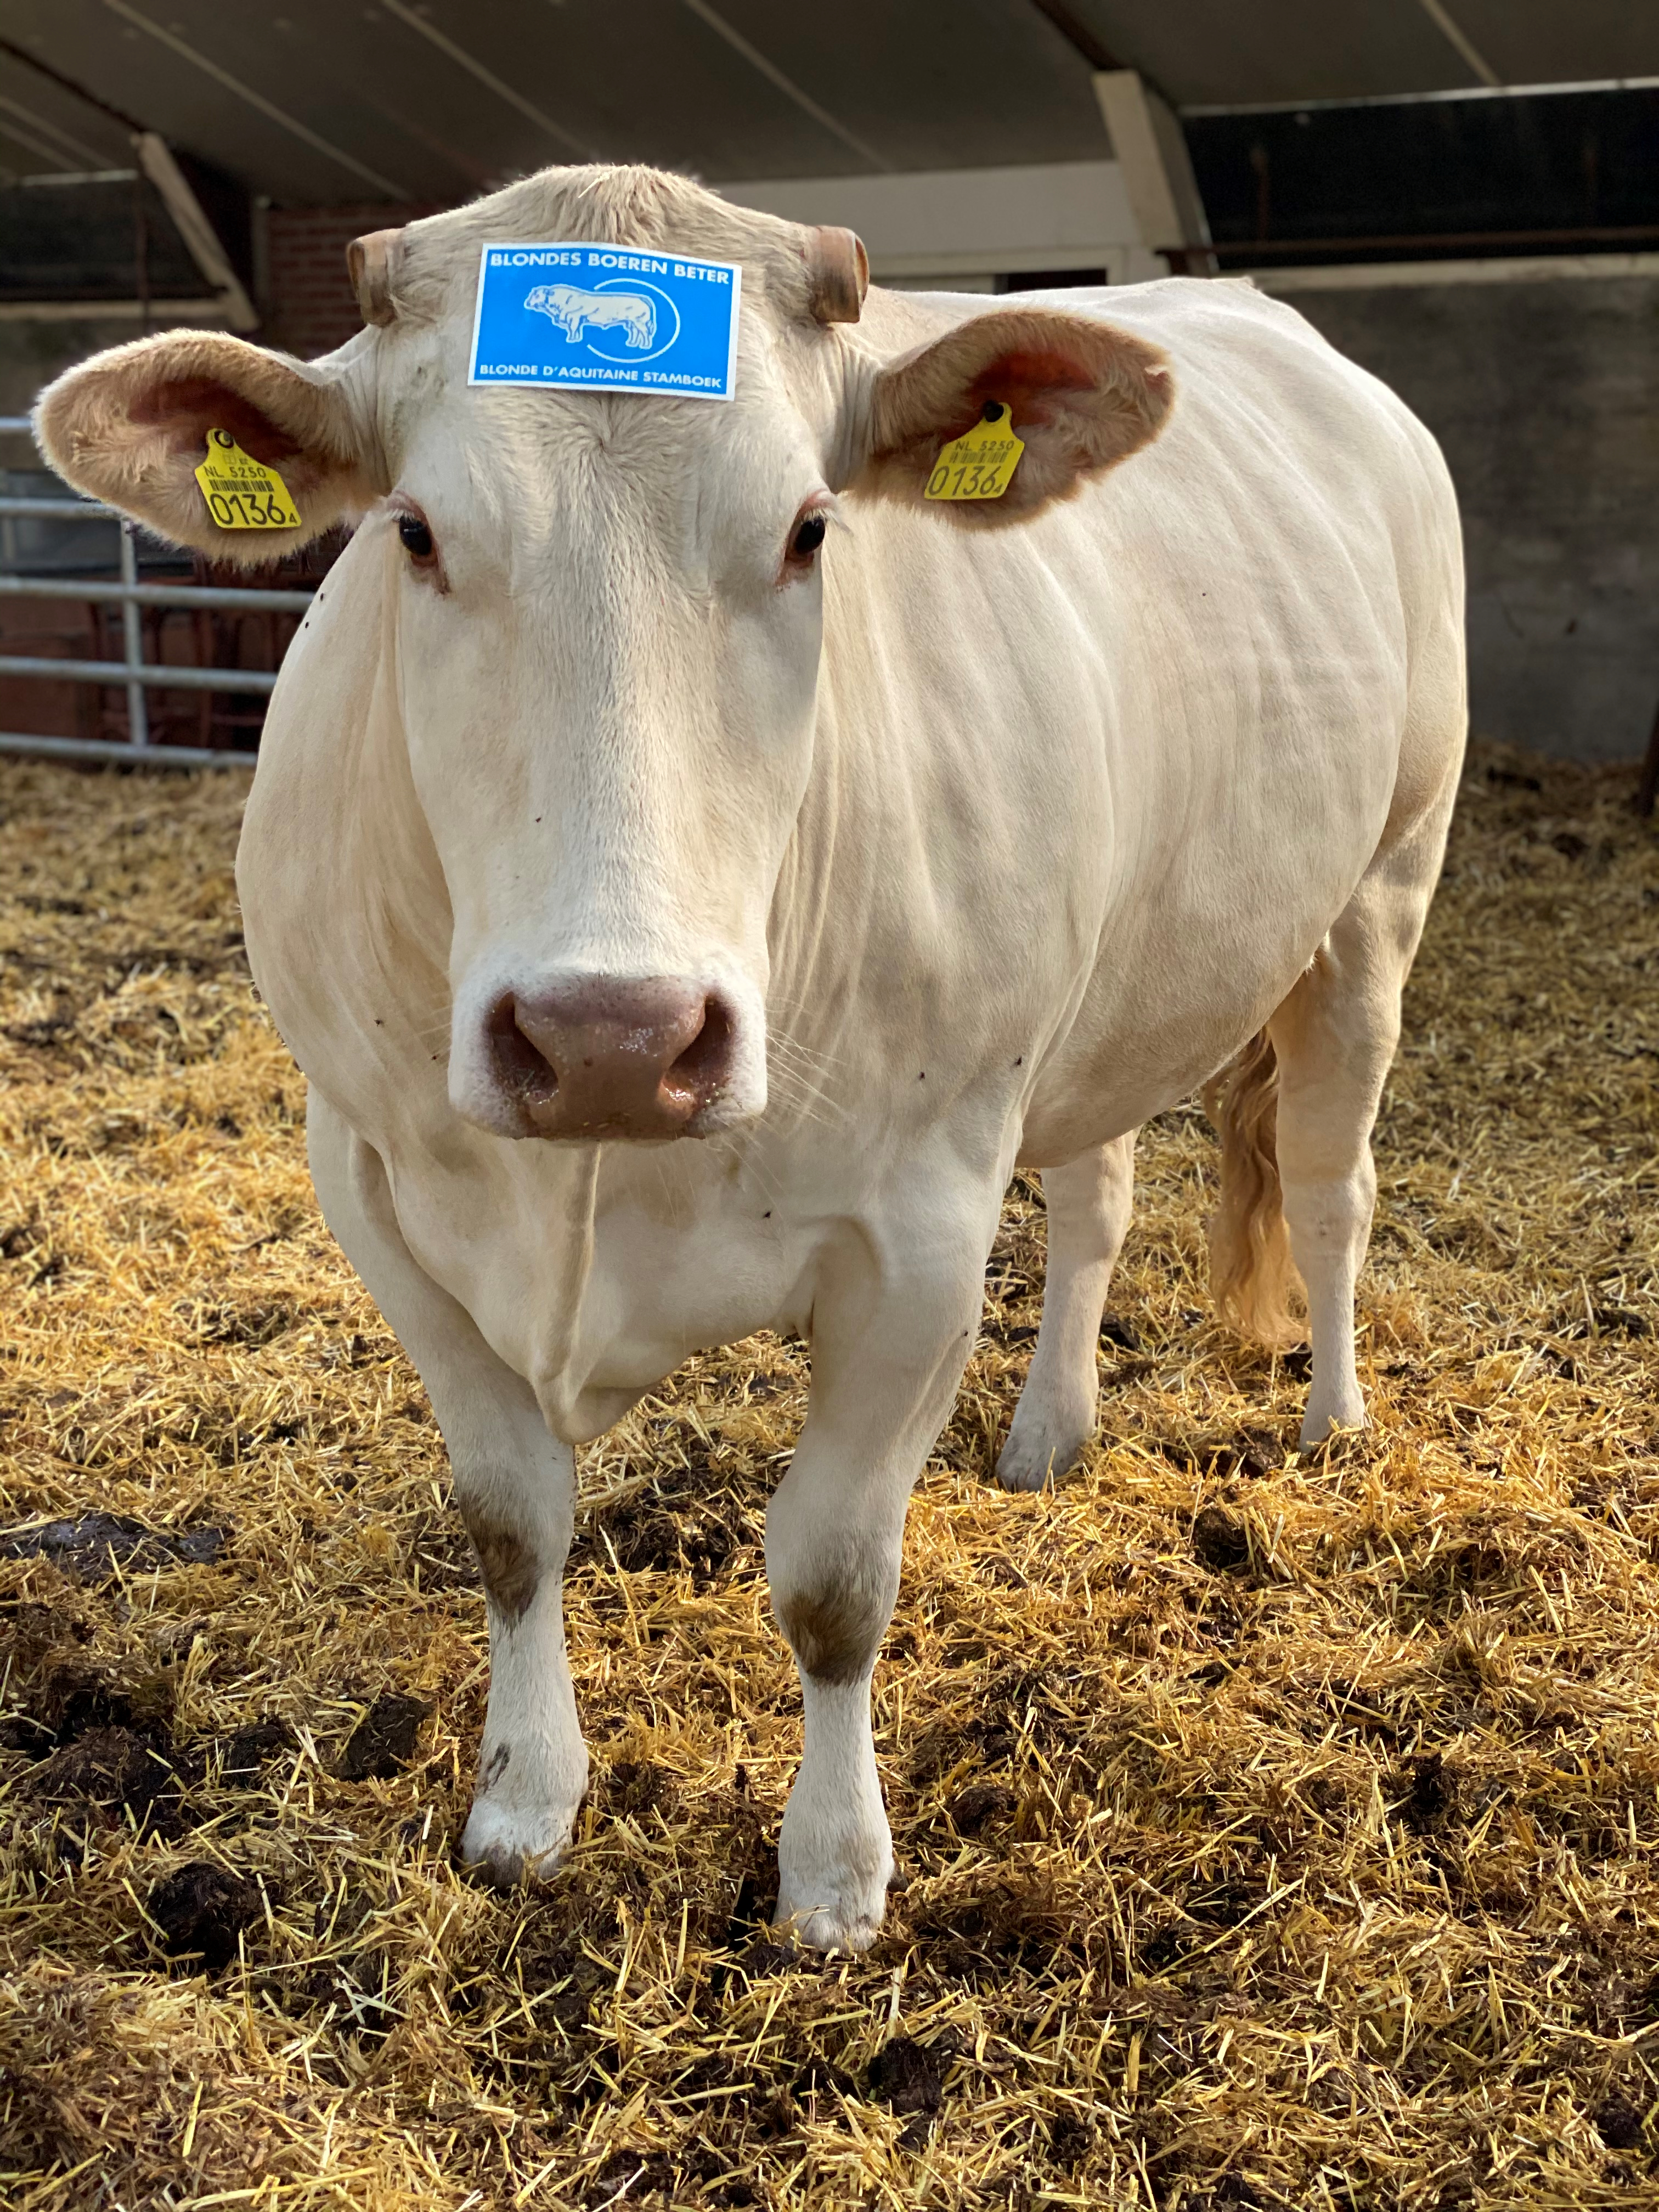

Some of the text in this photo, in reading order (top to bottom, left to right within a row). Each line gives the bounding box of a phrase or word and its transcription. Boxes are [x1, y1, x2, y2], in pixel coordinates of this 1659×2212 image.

[490, 253, 730, 284] BLONDES BOEREN BETER
[479, 364, 538, 376] BLONDE
[643, 371, 721, 388] STAMBOEK
[955, 440, 1014, 451] NL 5250
[203, 466, 266, 478] NL 5250
[210, 493, 286, 525] 0136
